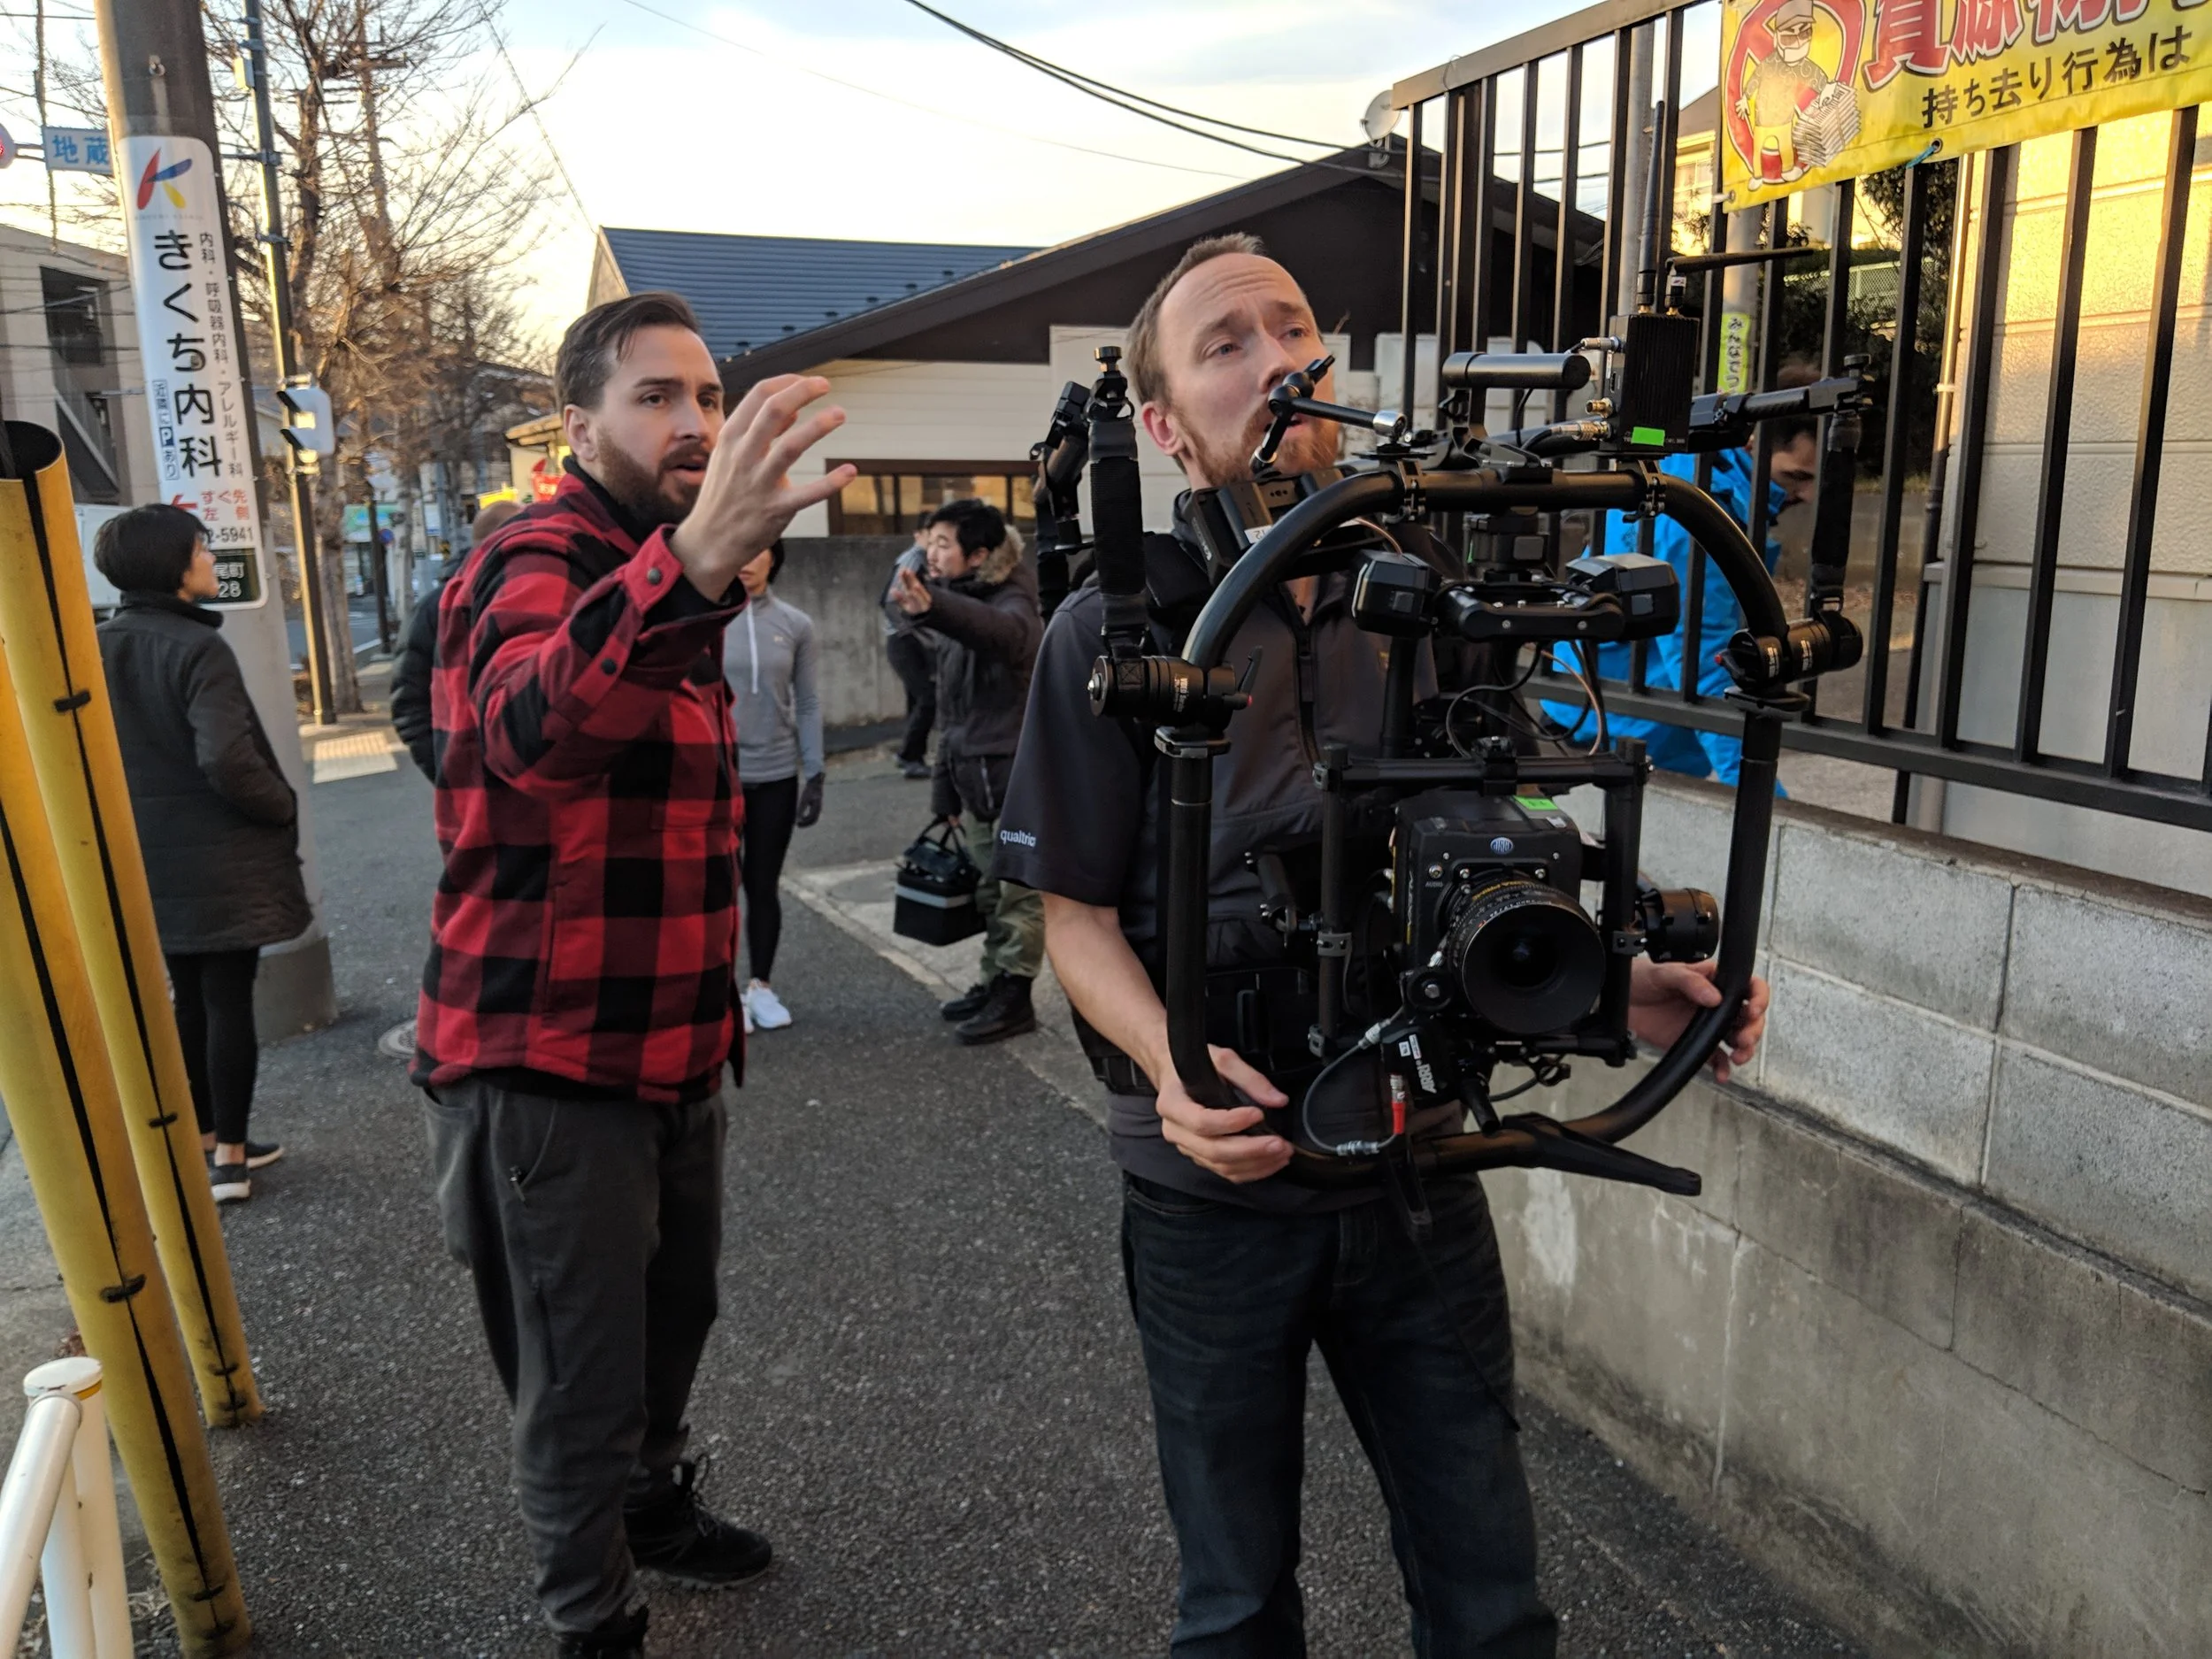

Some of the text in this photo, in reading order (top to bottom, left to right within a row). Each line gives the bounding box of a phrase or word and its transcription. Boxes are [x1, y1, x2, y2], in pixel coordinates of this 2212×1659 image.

[1921, 24, 2193, 129] 持ち去り行為は
[153, 228, 222, 478] きくち内科
